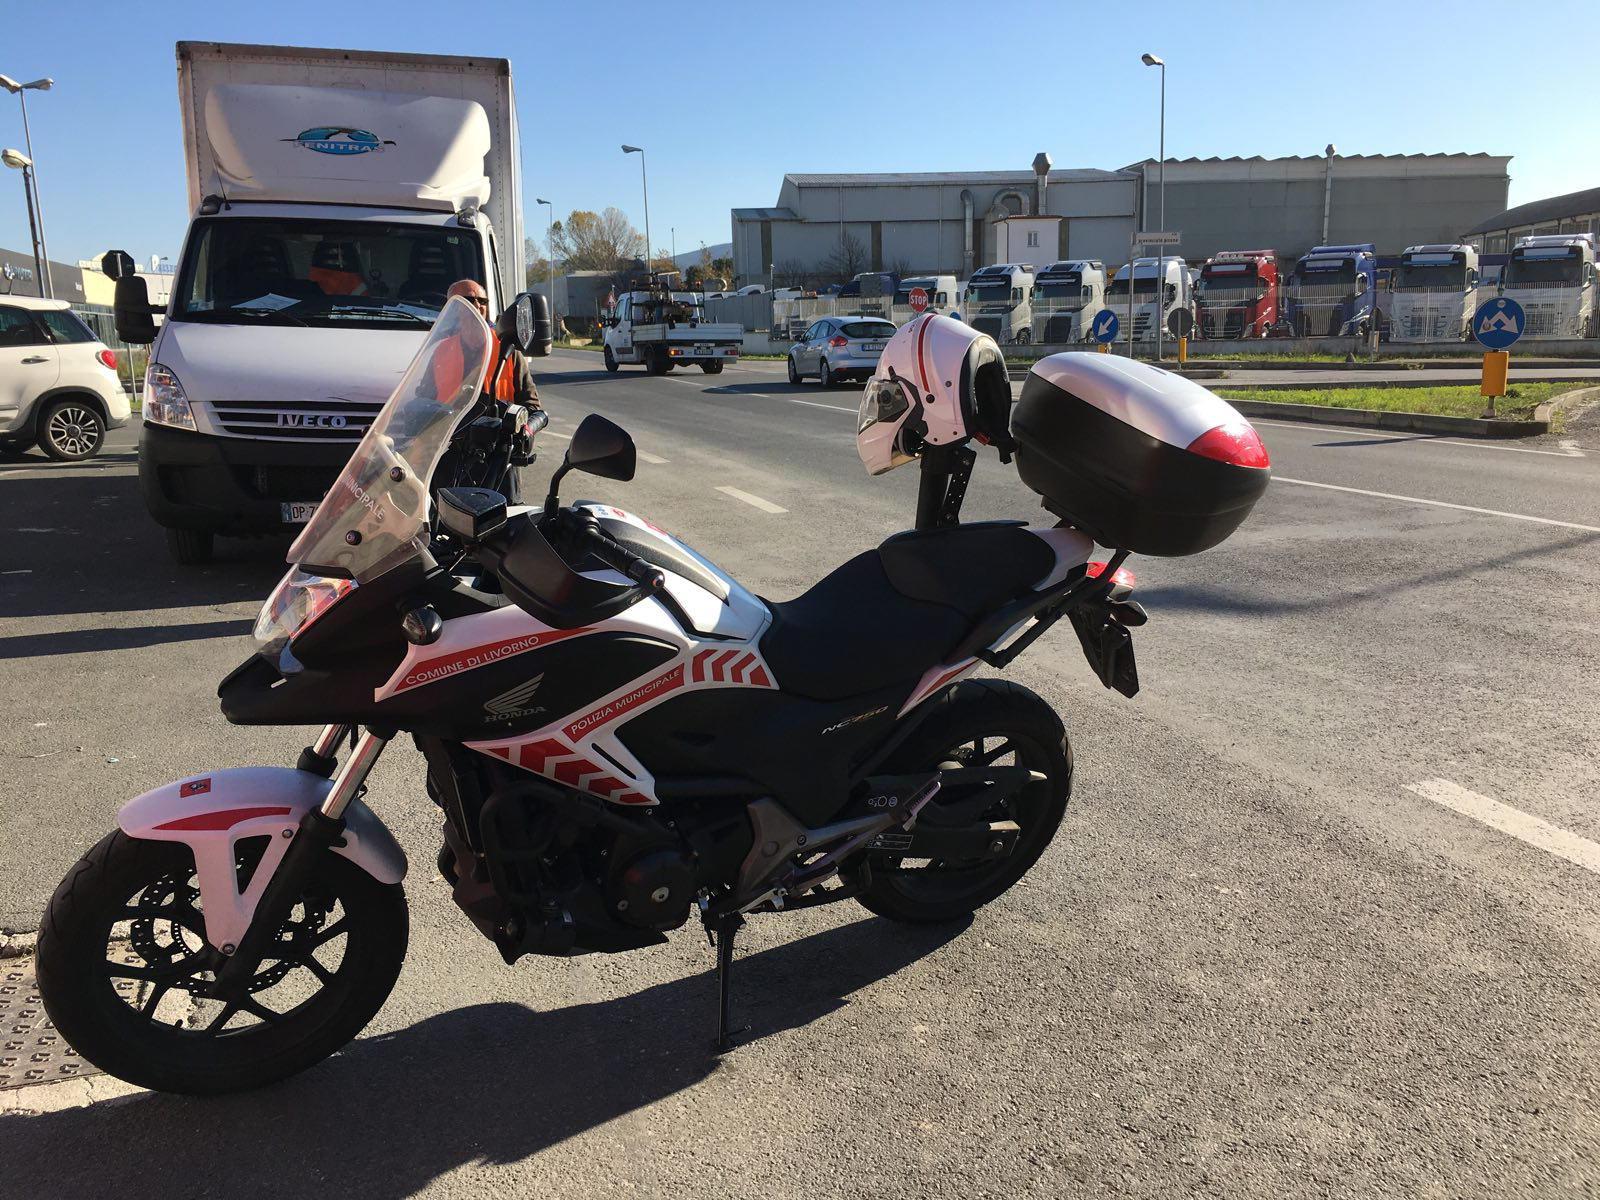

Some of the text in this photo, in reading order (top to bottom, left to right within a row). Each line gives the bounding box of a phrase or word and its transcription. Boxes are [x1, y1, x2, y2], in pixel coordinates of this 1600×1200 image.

[910, 294, 927, 306] STOP
[277, 412, 347, 429] IVECO
[405, 636, 540, 685] COMUNE DI LIVORNO
[570, 669, 681, 735] POLIZIA MUNICIPALE
[484, 706, 547, 722] HONDA
